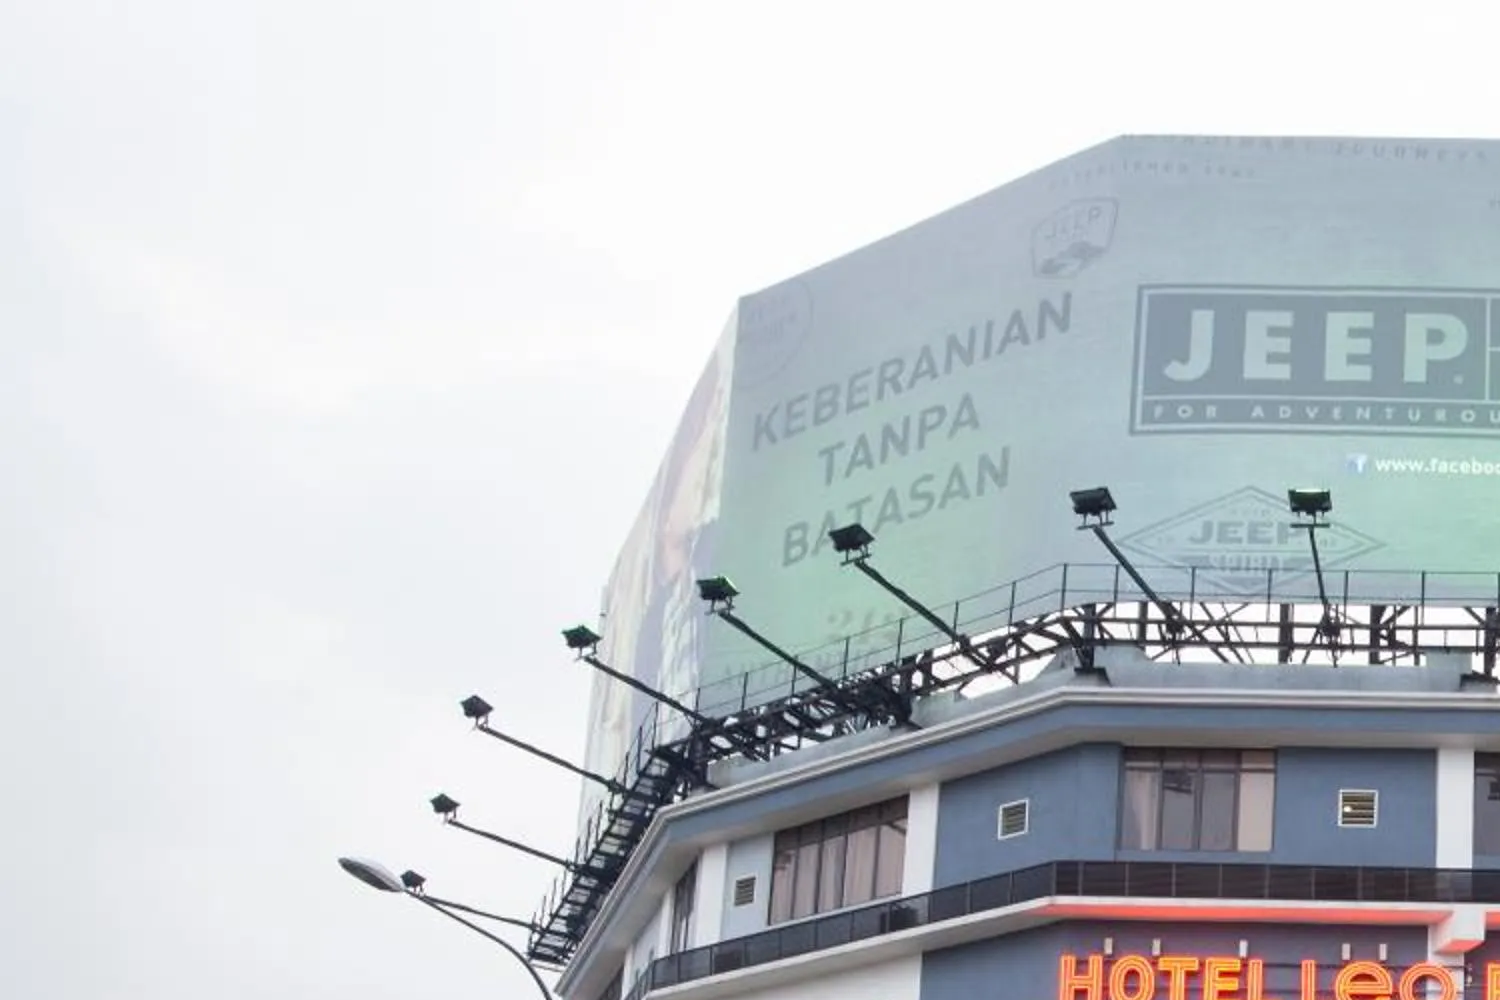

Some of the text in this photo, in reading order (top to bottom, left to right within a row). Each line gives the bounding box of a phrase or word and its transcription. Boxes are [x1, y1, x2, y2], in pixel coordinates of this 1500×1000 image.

[751, 290, 1073, 453] KEBERANIAN
[1163, 309, 1469, 384] JEEP
[817, 391, 981, 487] TANPA
[1152, 405, 1217, 419] FOR
[780, 445, 1012, 568] BATASAN
